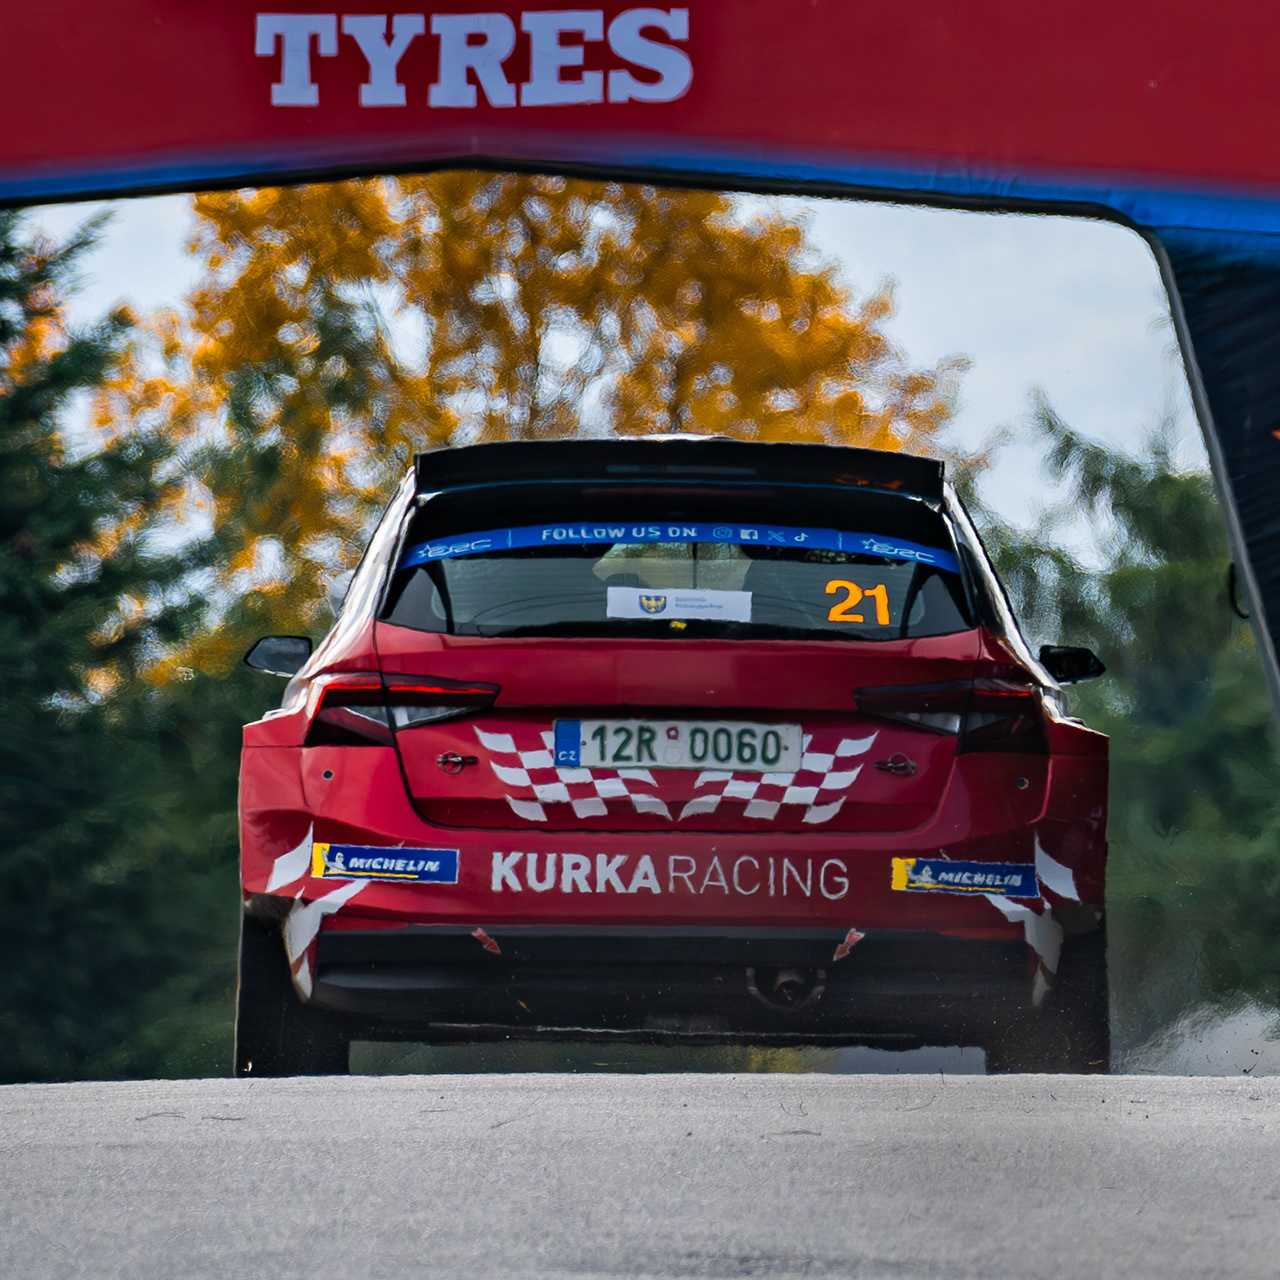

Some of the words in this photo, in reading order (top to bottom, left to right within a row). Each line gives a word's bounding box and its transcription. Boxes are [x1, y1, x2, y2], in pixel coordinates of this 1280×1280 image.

[254, 7, 694, 108] TYRES
[541, 527, 625, 540] FOLLOW
[631, 526, 661, 538] US
[669, 526, 697, 538] ON
[825, 579, 890, 626] 21
[592, 725, 657, 763] 12R
[689, 727, 781, 765] 0060
[349, 857, 439, 873] MICHELIN
